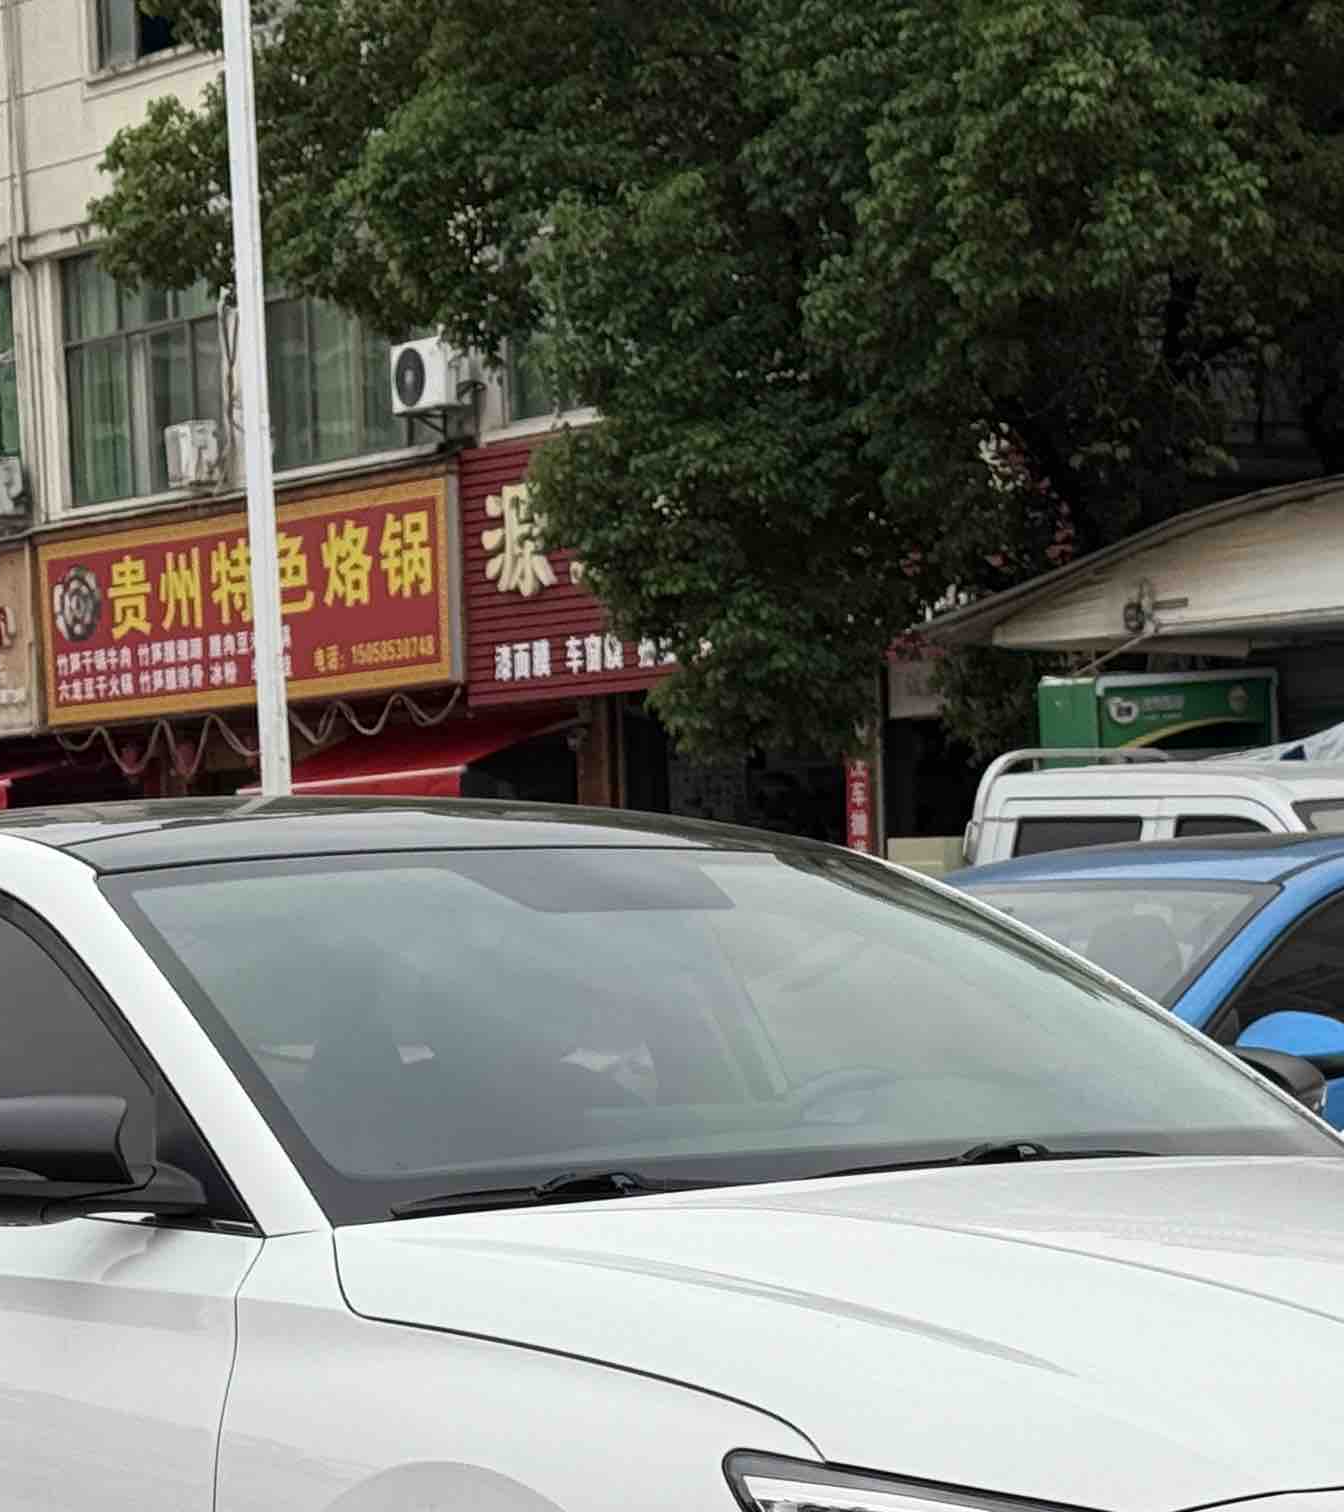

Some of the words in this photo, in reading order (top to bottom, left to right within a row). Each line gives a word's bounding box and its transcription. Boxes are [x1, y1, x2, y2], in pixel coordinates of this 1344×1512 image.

[107, 510, 433, 640] 贵州特色烙锅
